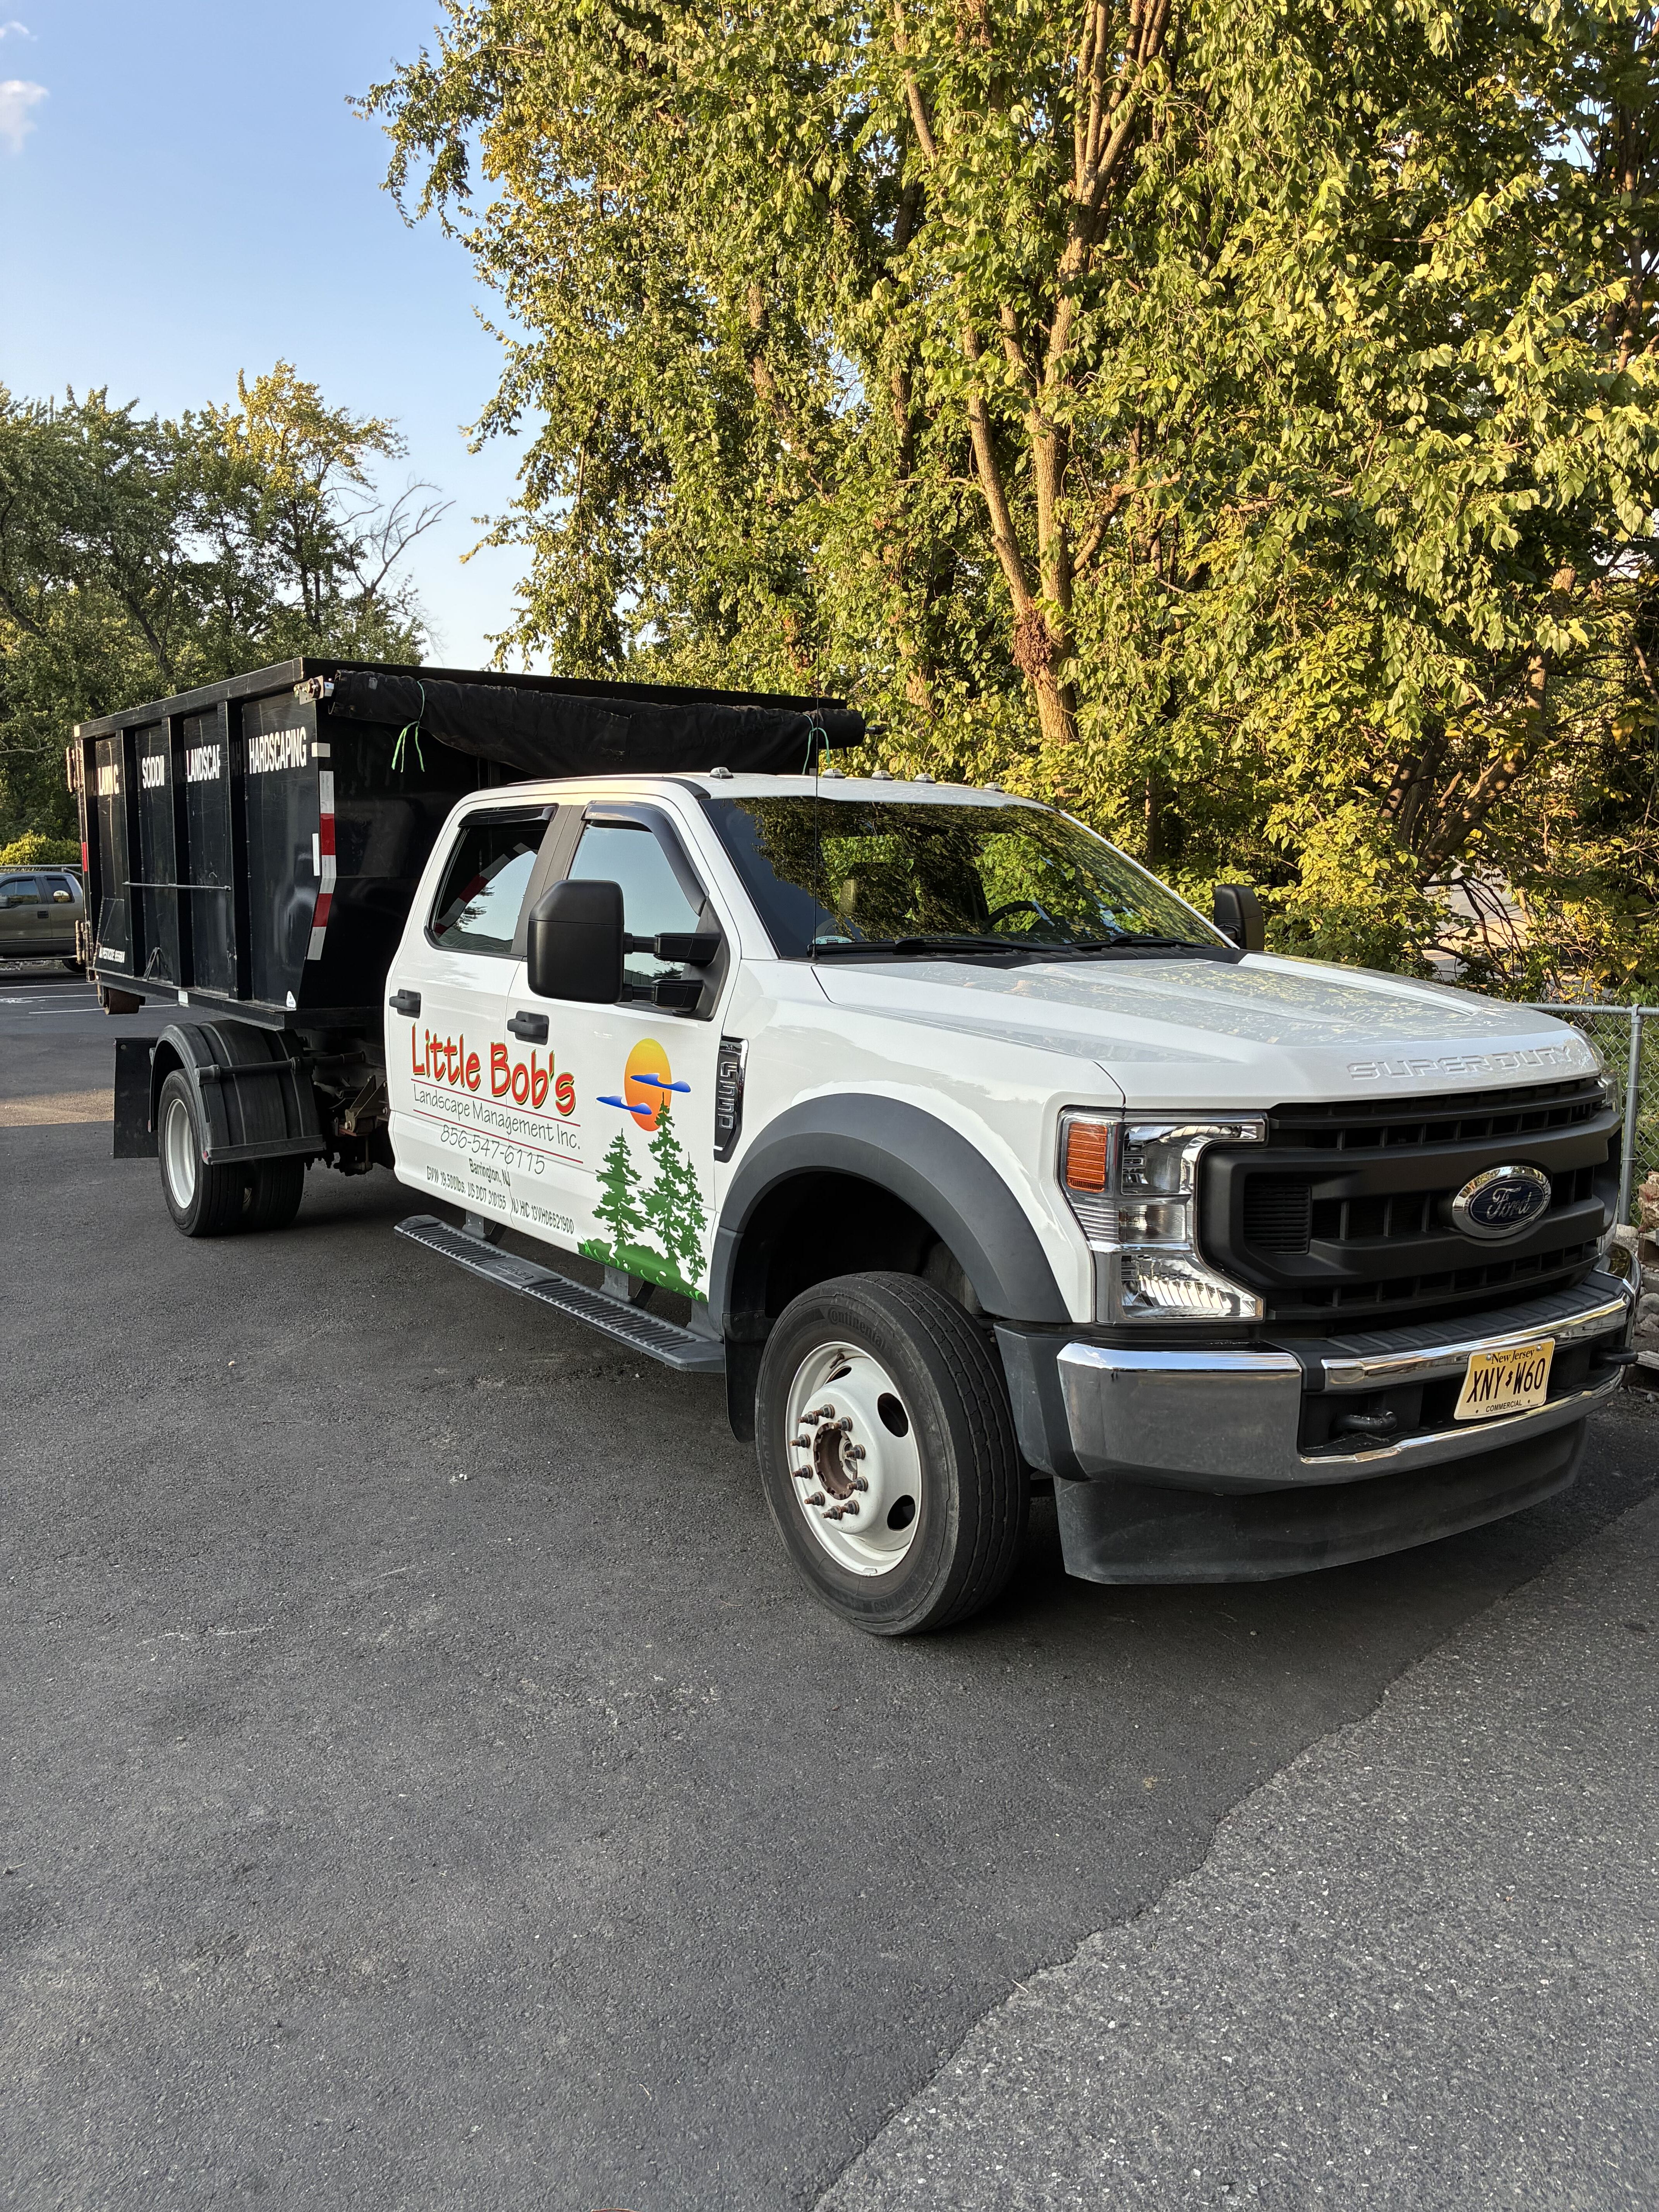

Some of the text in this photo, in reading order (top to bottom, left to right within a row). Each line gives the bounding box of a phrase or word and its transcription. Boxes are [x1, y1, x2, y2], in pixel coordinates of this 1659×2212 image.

[249, 726, 307, 775] HARDSCAPING
[98, 765, 113, 795] LAWN
[412, 1022, 576, 1117] Little Bob's
[1346, 1046, 1573, 1080] SUPER DUTY
[414, 1084, 580, 1150] Landscape Management Inc.
[440, 1124, 545, 1175] 856-547-6115
[469, 1158, 511, 1187] Barrington, NJ
[427, 1165, 574, 1235] GVW 19,500lbs. US DOT 310155 NJ HIC 13VH06621900
[1486, 1186, 1532, 1220] Ford
[828, 1306, 886, 1352] Continental
[1491, 1349, 1535, 1364] New Jersey
[1466, 1358, 1546, 1403] XNY W60
[1486, 1399, 1522, 1413] COMMERCIAL
